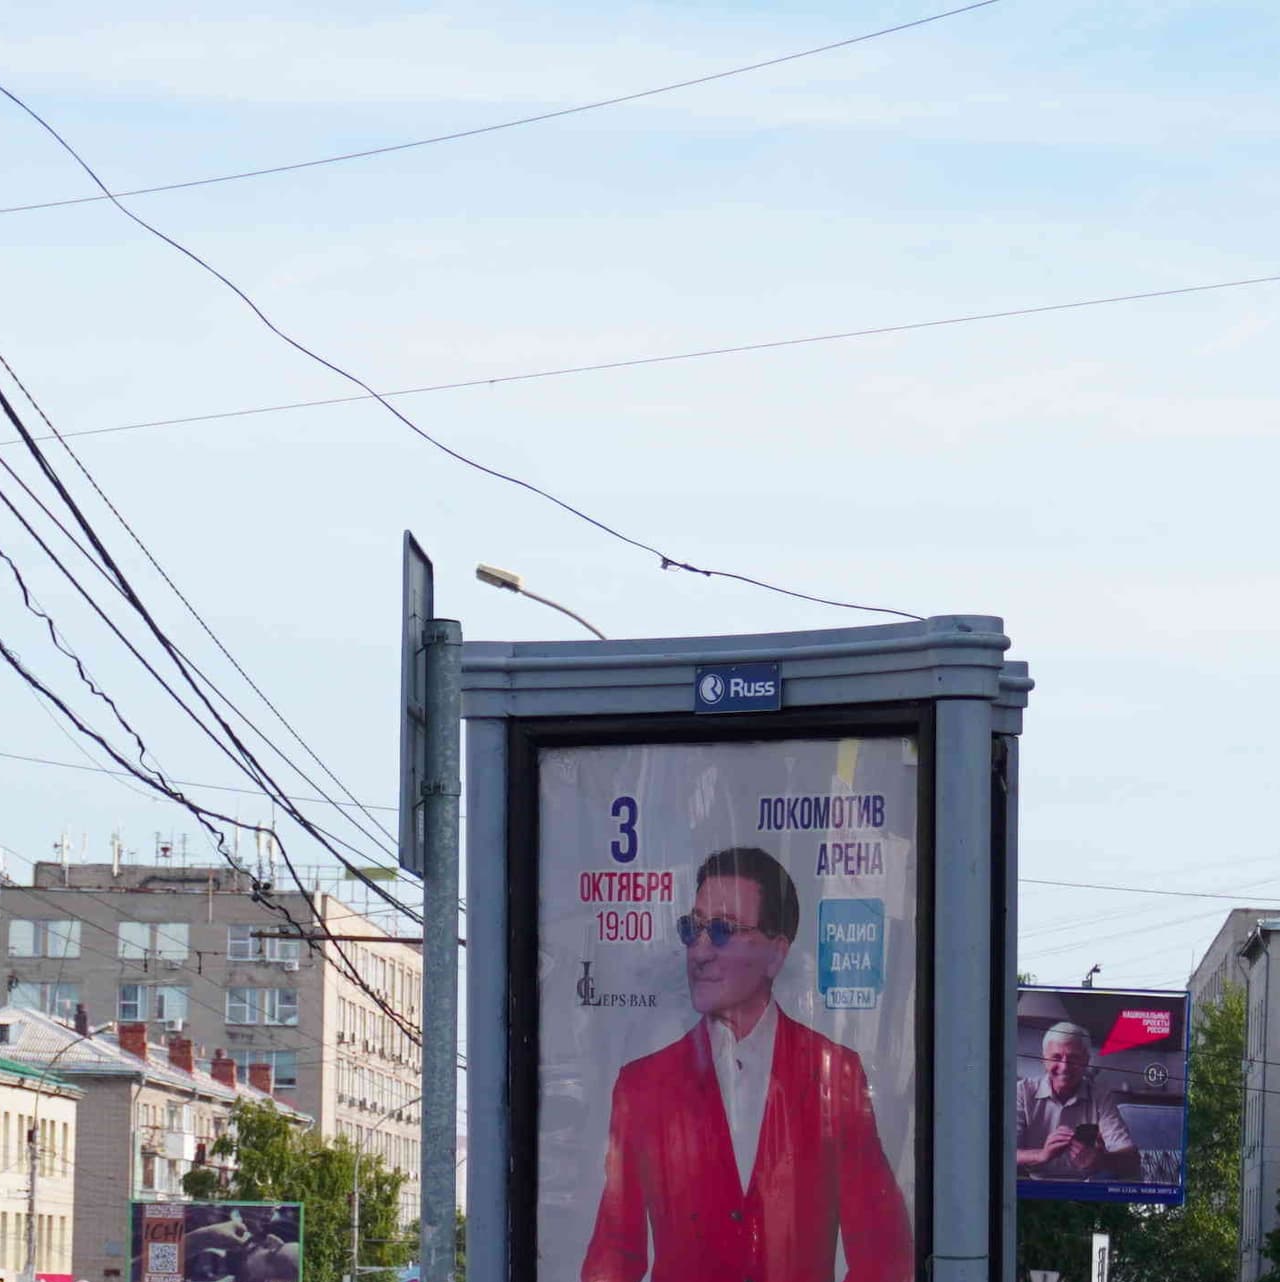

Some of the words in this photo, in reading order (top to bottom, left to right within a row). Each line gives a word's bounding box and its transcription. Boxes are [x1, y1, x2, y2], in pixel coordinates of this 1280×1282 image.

[730, 677, 775, 699] Russ
[757, 794, 886, 832] ЛОКОМОТИВ
[610, 796, 638, 863] 3
[816, 842, 884, 877] АРЕНА
[580, 872, 674, 903] ОКТЯБРЯ
[597, 911, 653, 942] 19:00
[826, 923, 876, 942] РАДИО
[831, 952, 871, 972] ДАЧА
